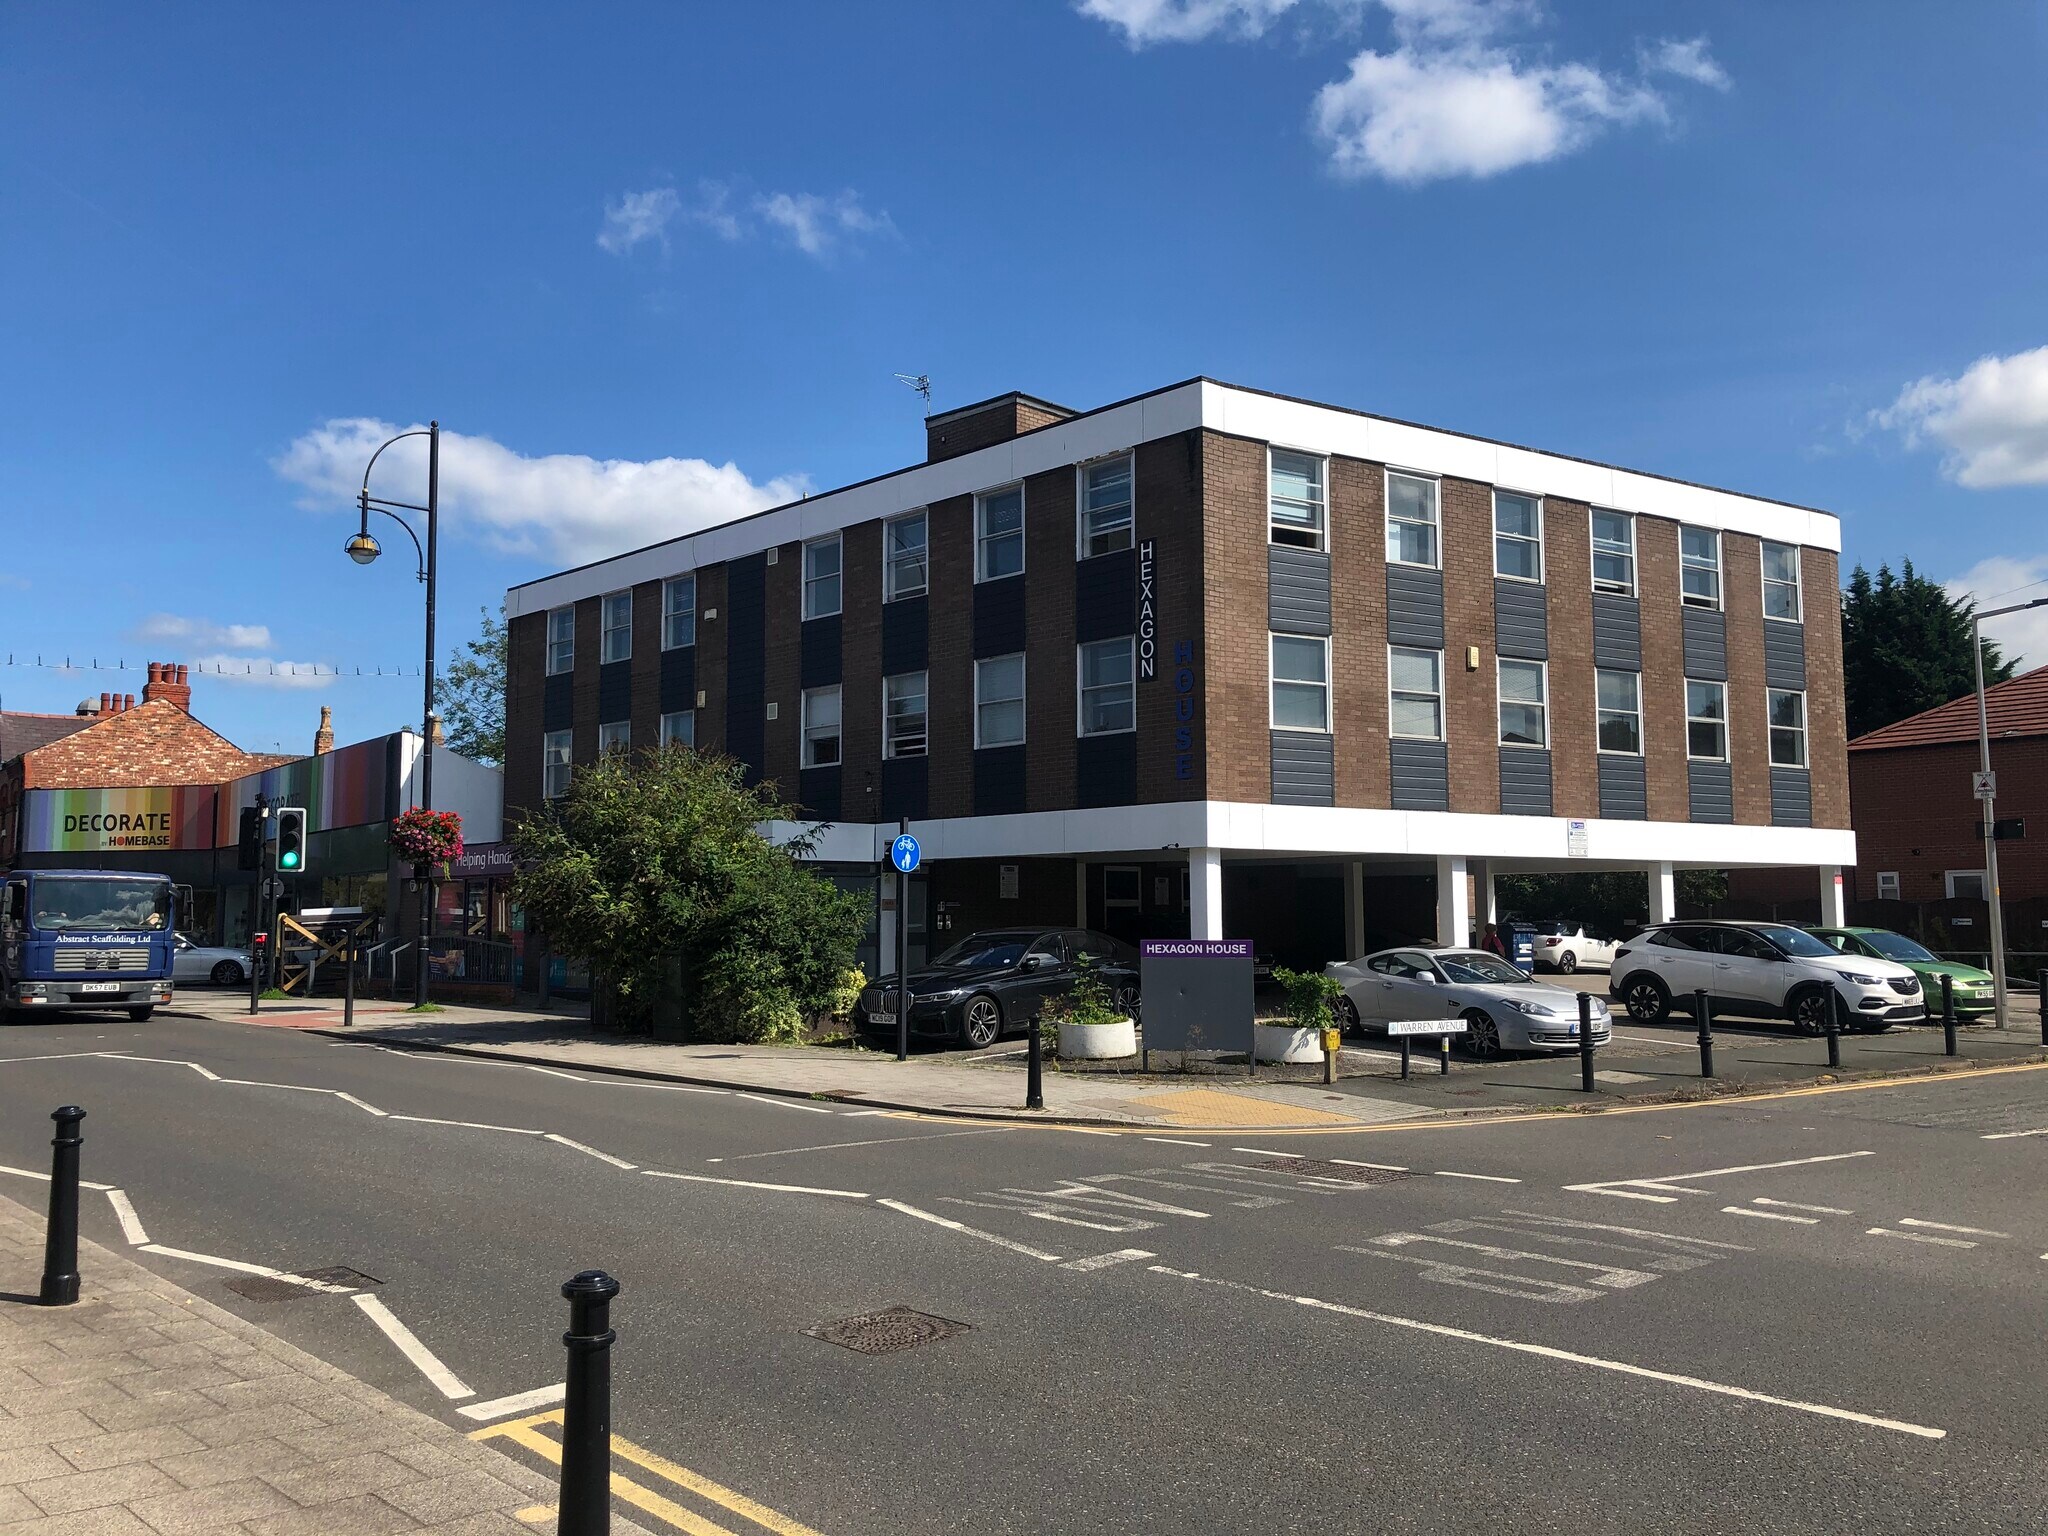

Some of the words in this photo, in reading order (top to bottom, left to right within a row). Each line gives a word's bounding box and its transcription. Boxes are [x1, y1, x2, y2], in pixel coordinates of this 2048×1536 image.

[1140, 541, 1154, 677] HEXAGON
[1174, 640, 1195, 780] HOUSE
[64, 813, 171, 832] DECORATE
[109, 835, 170, 846] HOMEBASE
[55, 935, 90, 943] Abstract
[91, 935, 136, 944] Scaffolding
[137, 935, 151, 943] Ltd
[1146, 944, 1203, 954] HEXAGON
[1206, 944, 1247, 954] HOUSE
[1400, 1022, 1434, 1032] WARREN
[1437, 1020, 1466, 1031] AVENUE
